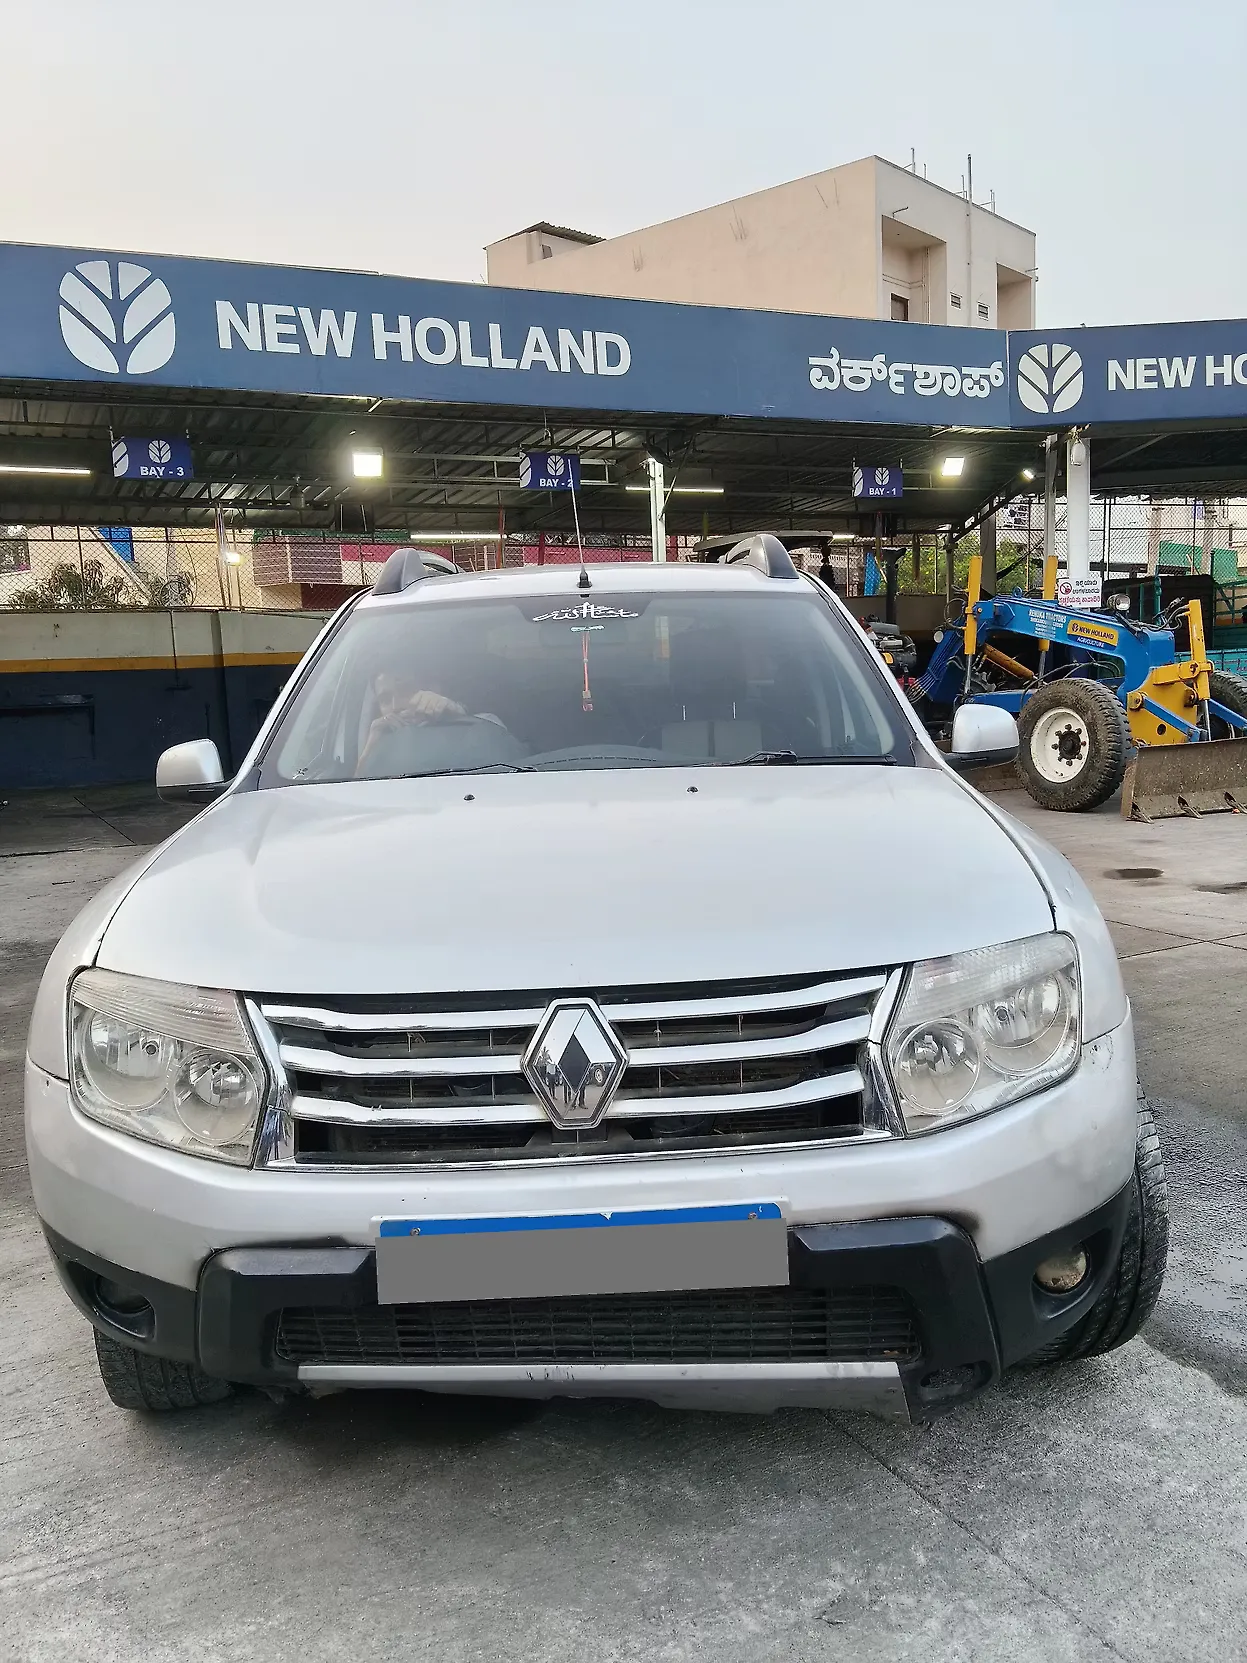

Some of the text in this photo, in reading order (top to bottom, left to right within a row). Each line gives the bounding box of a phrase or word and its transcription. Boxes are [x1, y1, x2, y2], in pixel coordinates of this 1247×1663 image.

[215, 300, 632, 376] NEW HOLLAND
[1107, 356, 1197, 391] NEW
[140, 466, 165, 477] BAY
[176, 466, 184, 476] 3
[540, 478, 559, 487] BAY
[567, 479, 573, 487] 2
[869, 487, 885, 496] BAY
[891, 487, 896, 496] 1
[1079, 626, 1114, 640] NEW HOLLAND
[1077, 636, 1105, 648] AGRICULTURE
